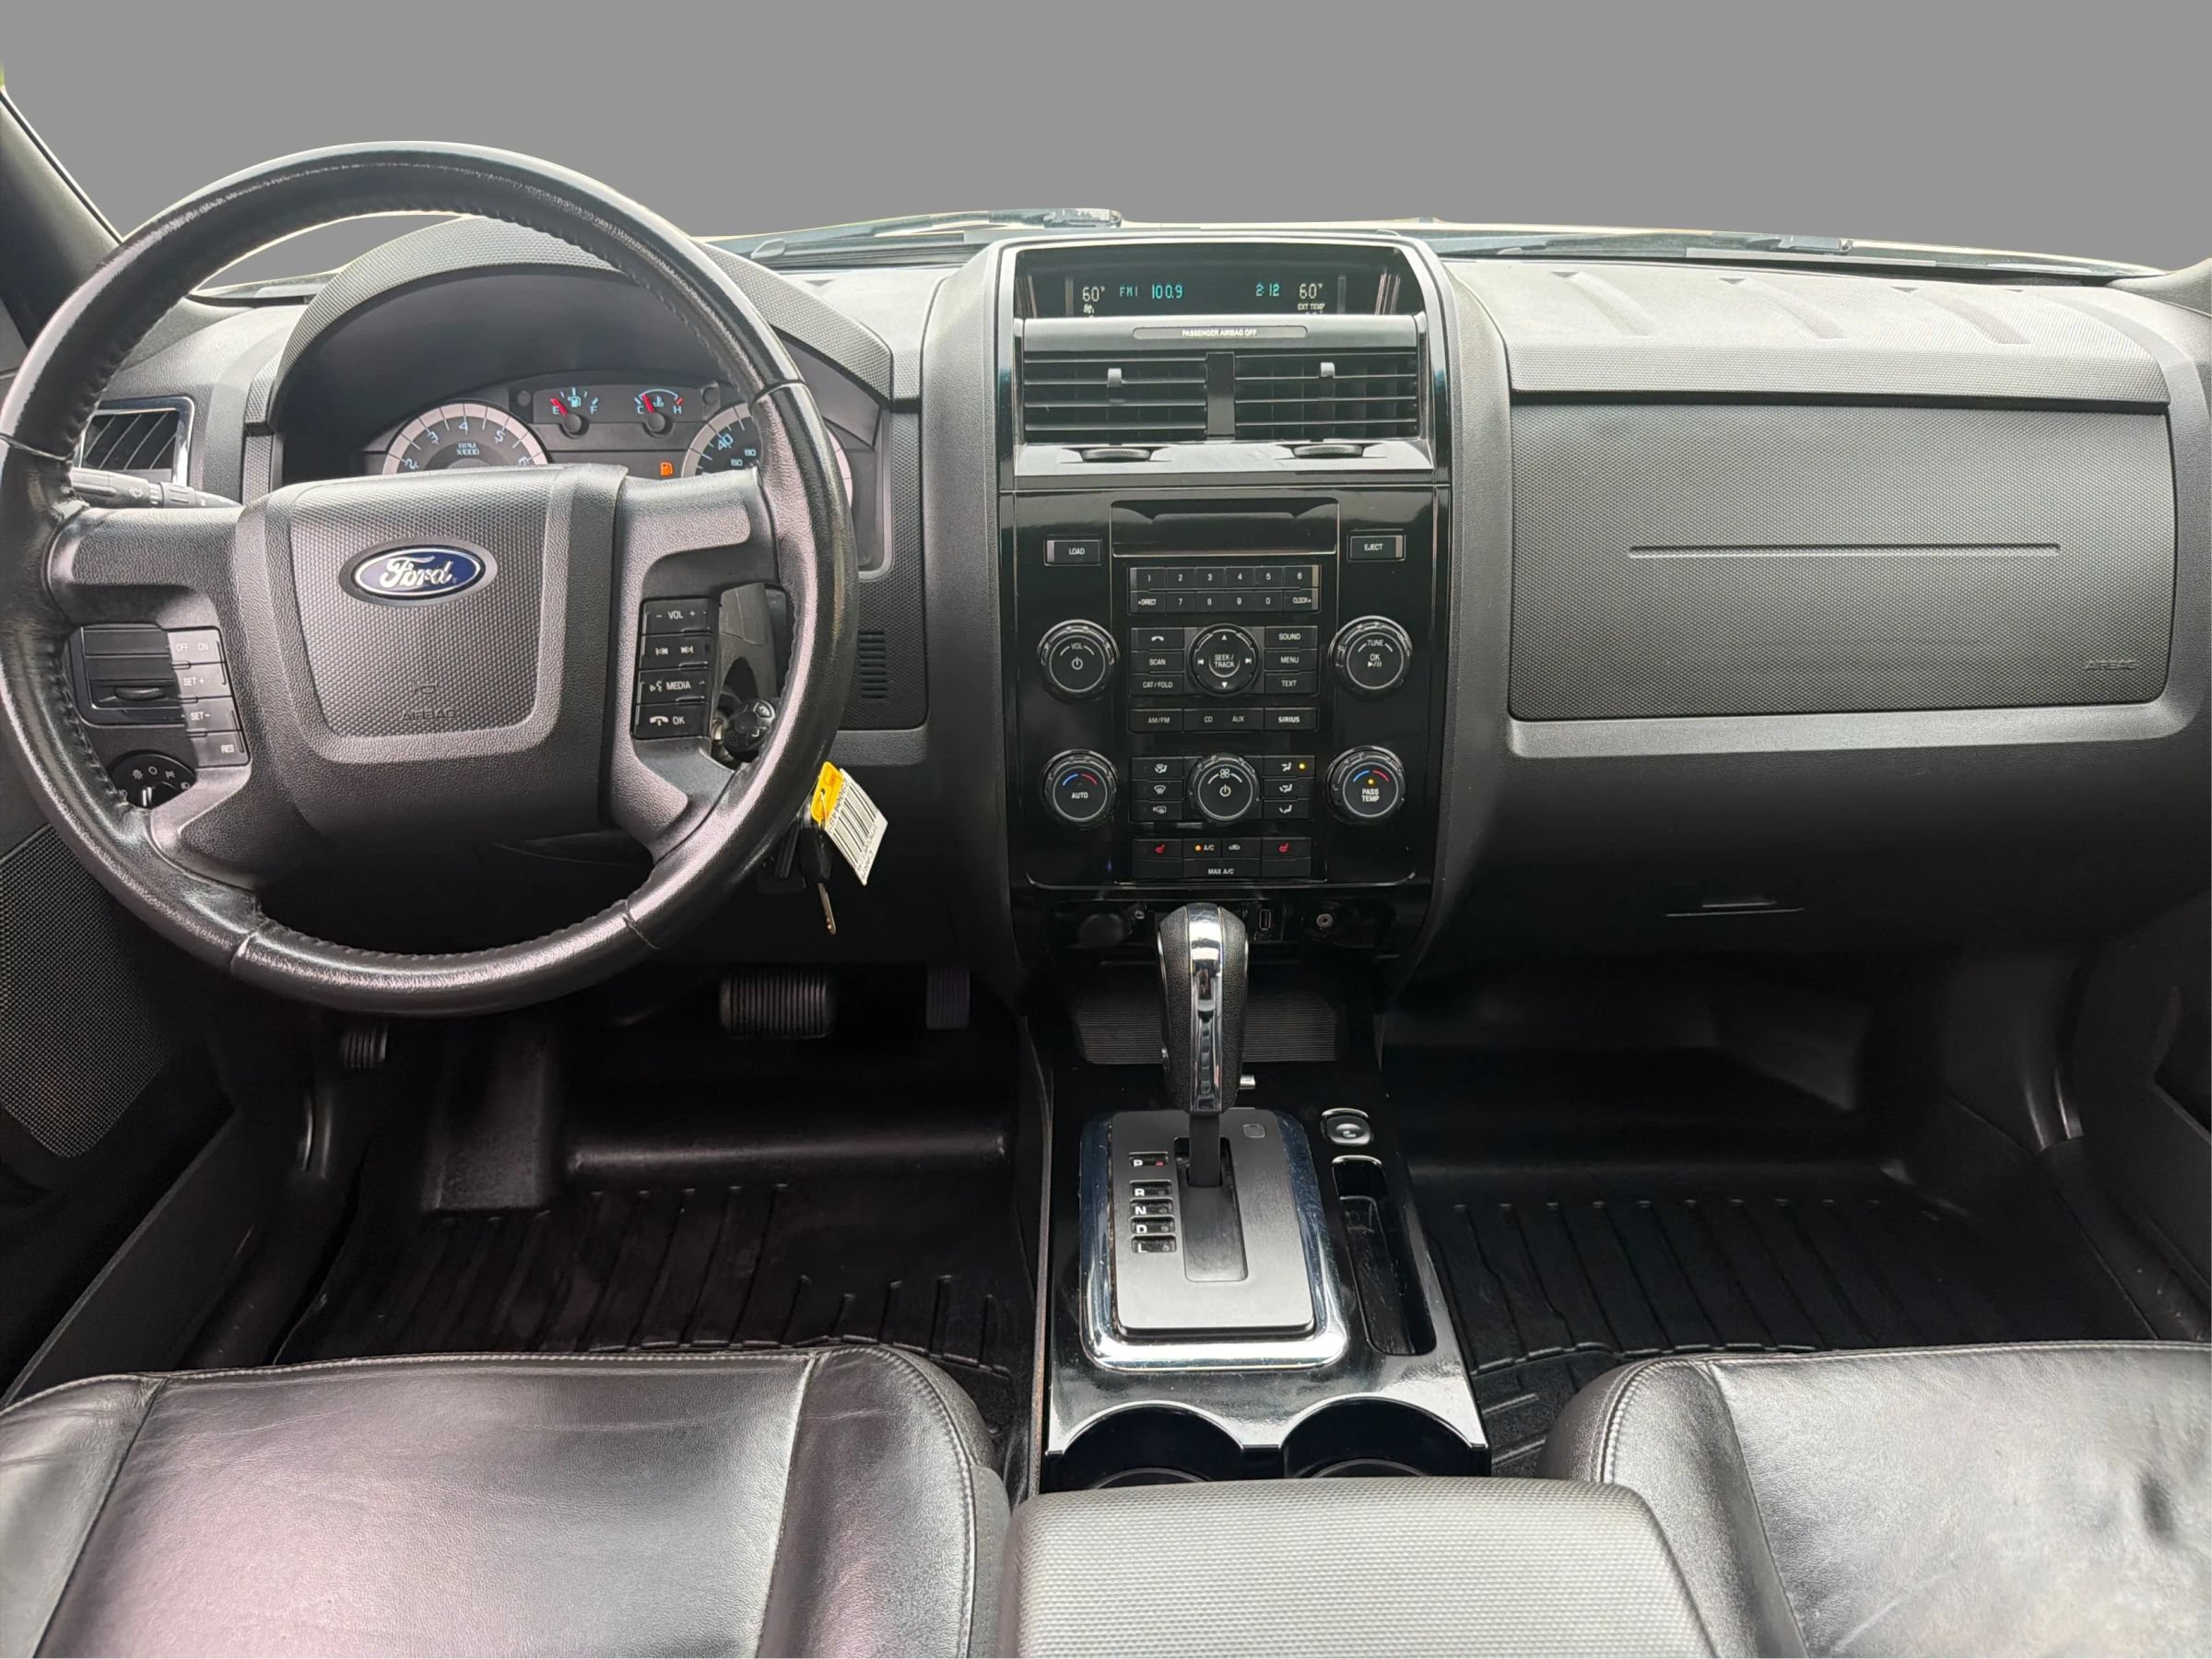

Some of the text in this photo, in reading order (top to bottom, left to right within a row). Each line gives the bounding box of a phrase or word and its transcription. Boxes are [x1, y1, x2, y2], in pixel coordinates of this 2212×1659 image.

[1151, 284, 1183, 300] 100.9
[1182, 328, 1257, 337] PASSENGER AIRBAG OFF
[553, 406, 560, 414] E
[590, 406, 597, 414] F
[637, 406, 644, 415] C
[458, 419, 468, 435] 4
[427, 430, 439, 446] 3
[494, 429, 506, 444] 5
[718, 433, 735, 451] 40
[1068, 547, 1086, 556] LOAD
[1364, 543, 1383, 551] EJECT
[379, 556, 453, 589] Ford
[1147, 574, 1152, 582] 1
[1207, 573, 1213, 582] 3
[1237, 572, 1242, 581] 4
[1265, 572, 1271, 581] 5
[1265, 597, 1271, 606] 0
[668, 610, 684, 619] VOL
[176, 642, 208, 652] OFF ON
[1280, 656, 1299, 665] MENU
[1370, 653, 1381, 662] OK
[183, 677, 196, 686] SET
[665, 681, 691, 690] MEDIA
[672, 716, 686, 725] OK
[1147, 716, 1171, 724] AM/FM
[221, 745, 235, 754] RES
[1071, 792, 1089, 800] AUTO
[1361, 794, 1380, 803] TEMP
[1133, 1159, 1143, 1167] P
[1135, 1188, 1145, 1196] R
[1135, 1206, 1147, 1215] N
[1136, 1225, 1147, 1234] D
[1138, 1242, 1147, 1253] L
